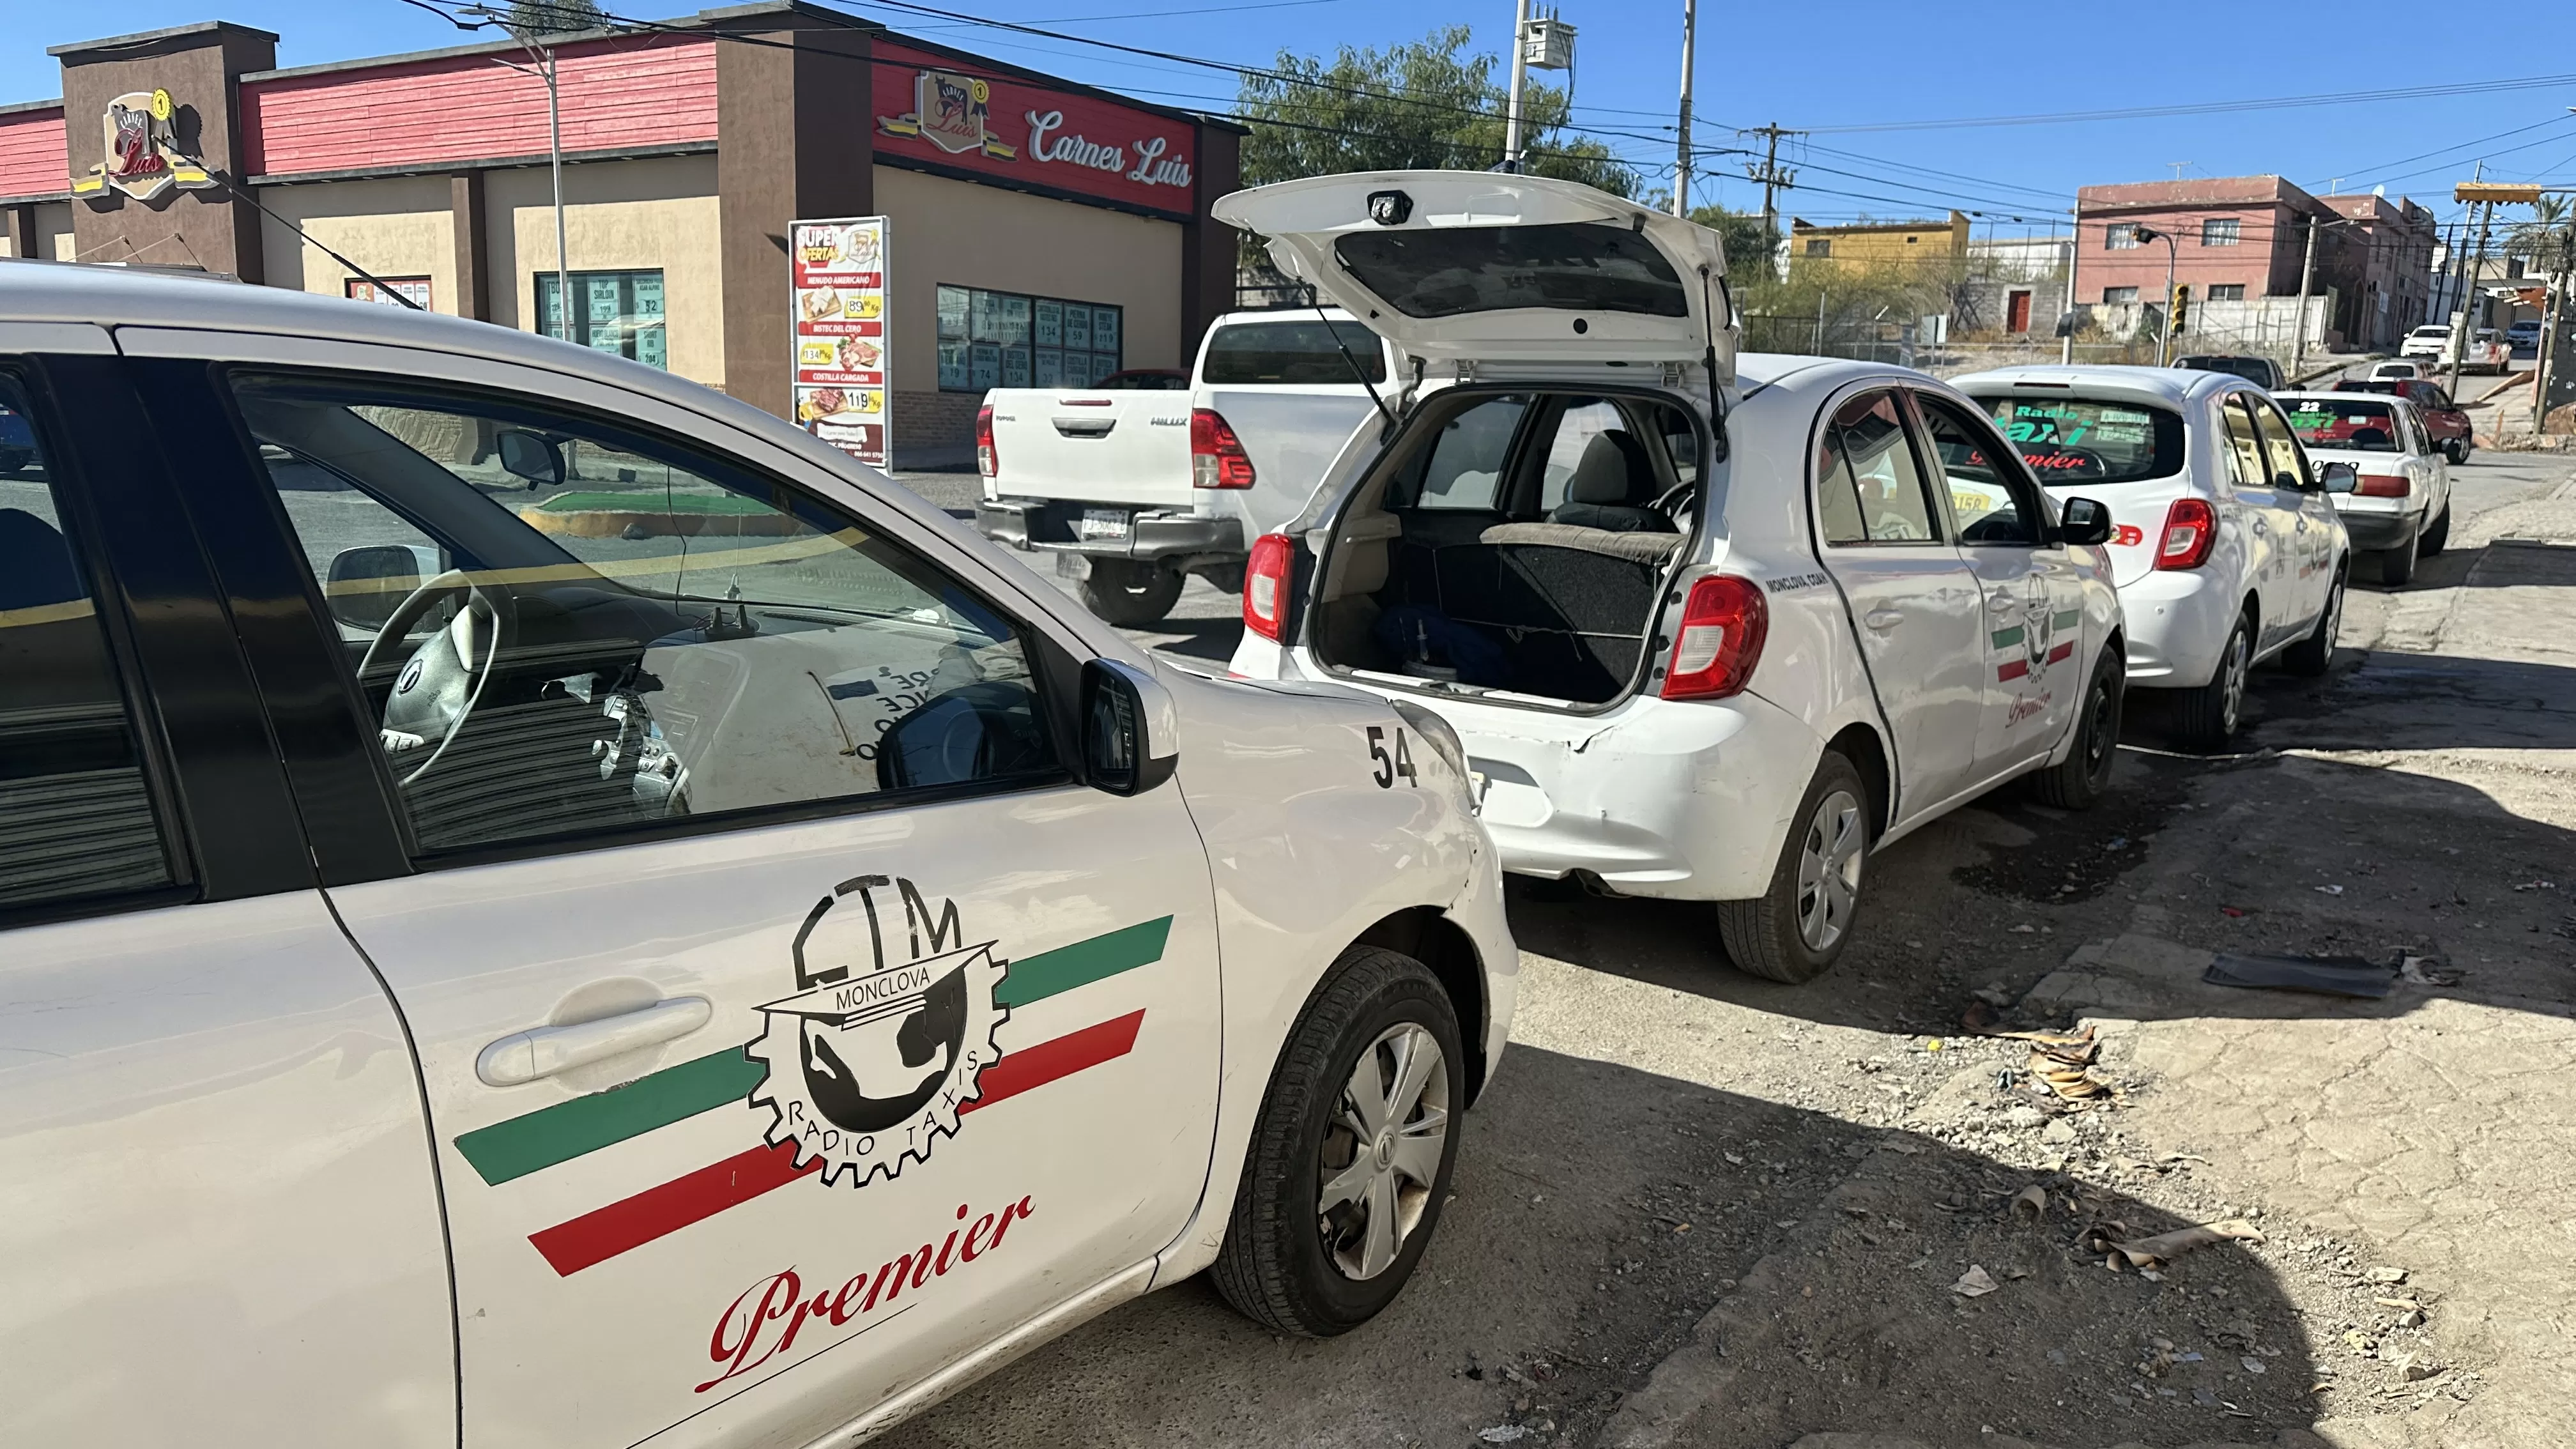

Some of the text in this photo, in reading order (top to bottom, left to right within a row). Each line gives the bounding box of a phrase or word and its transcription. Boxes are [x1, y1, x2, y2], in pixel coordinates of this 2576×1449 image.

[925, 102, 977, 138] Luis
[107, 128, 164, 177] Luis
[1026, 110, 1192, 188] Carnes Luis
[797, 228, 839, 247] SUPER
[799, 247, 839, 261] OFERTAS
[599, 280, 609, 289] TOP
[807, 275, 870, 284] MENUDO AMERICANO
[813, 372, 869, 382] COSTILLA CARGADA
[2015, 406, 2078, 420] Radio
[2299, 403, 2320, 411] 22
[1151, 417, 1188, 426] HILUX
[1766, 576, 1811, 593] MONCLOVA,
[2005, 687, 2052, 728] Premier
[1367, 726, 1418, 789] 54
[836, 967, 930, 1011] MONCLOVA
[788, 1050, 978, 1156] RADIO TAXIS
[694, 1194, 1036, 1393] Premier
